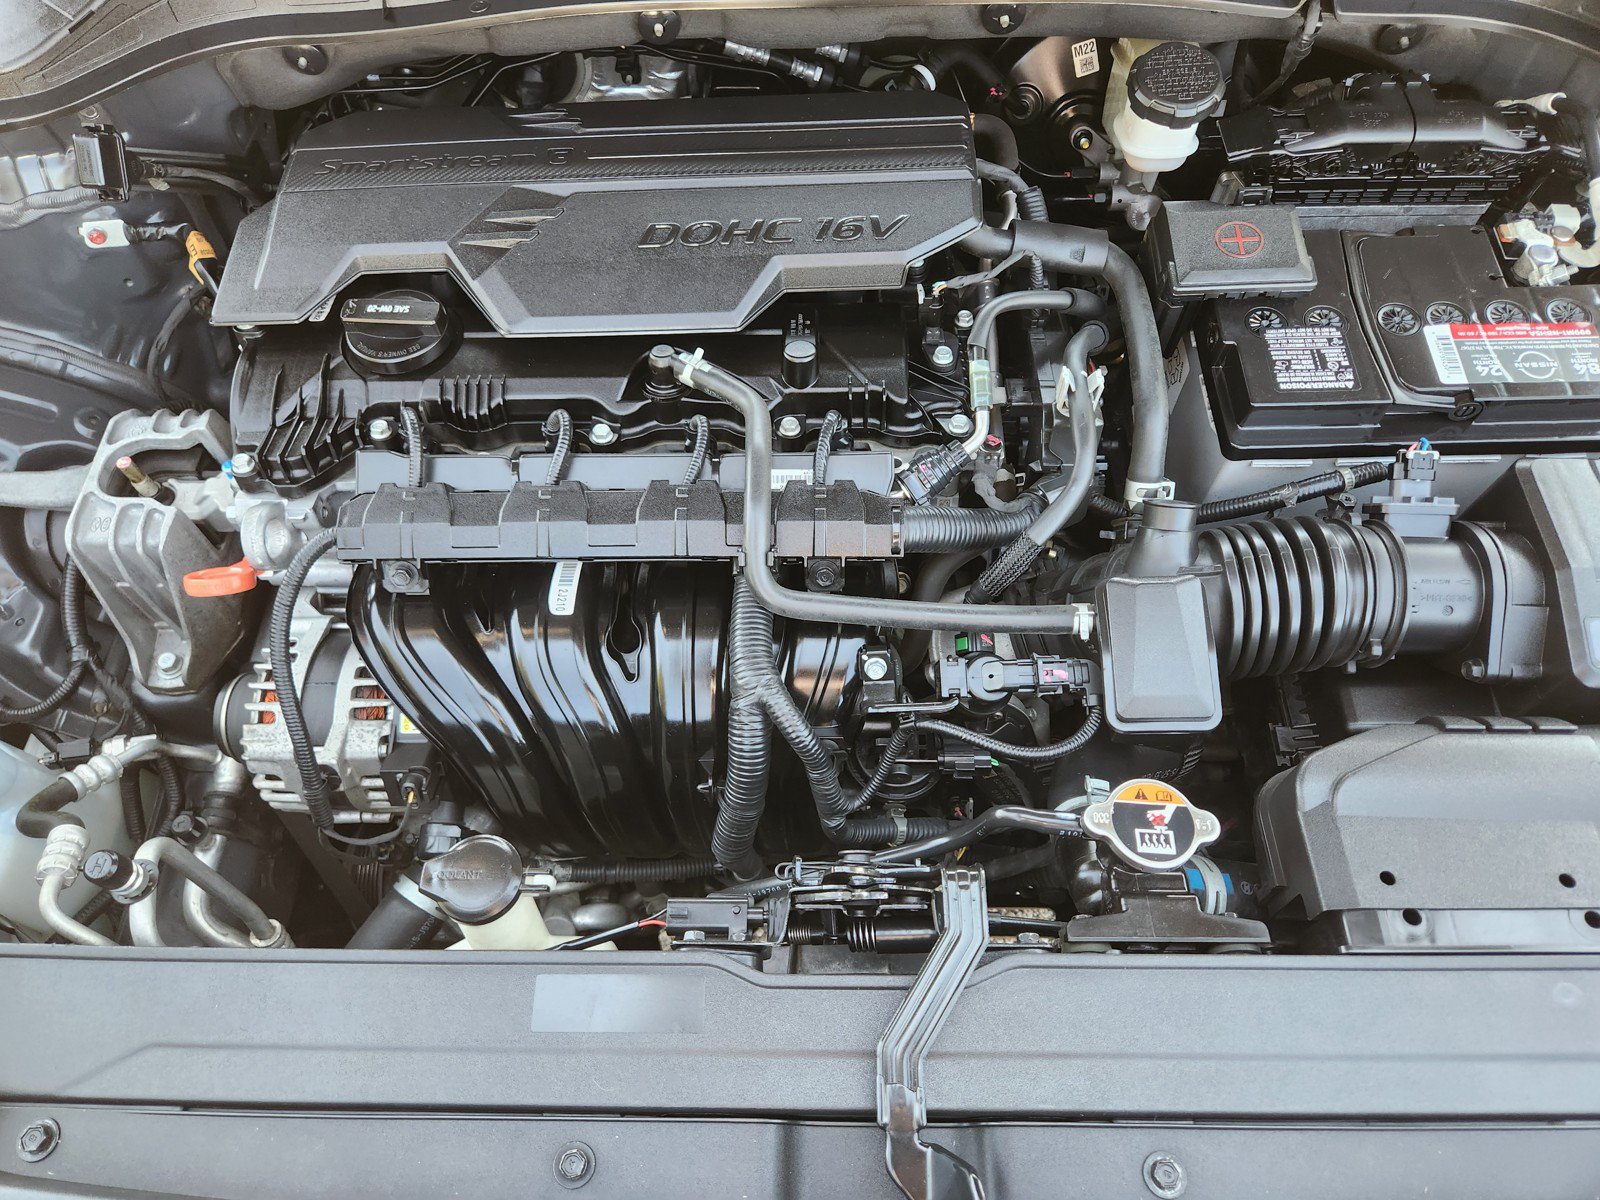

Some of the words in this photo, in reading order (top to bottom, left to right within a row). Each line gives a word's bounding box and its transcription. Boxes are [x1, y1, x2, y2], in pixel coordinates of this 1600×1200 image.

[1073, 41, 1096, 58] M22
[313, 153, 537, 175] Smartstream
[637, 218, 803, 248] DOHC
[814, 214, 911, 242] 16V
[393, 304, 411, 313] SAE
[1476, 365, 1503, 377] 24
